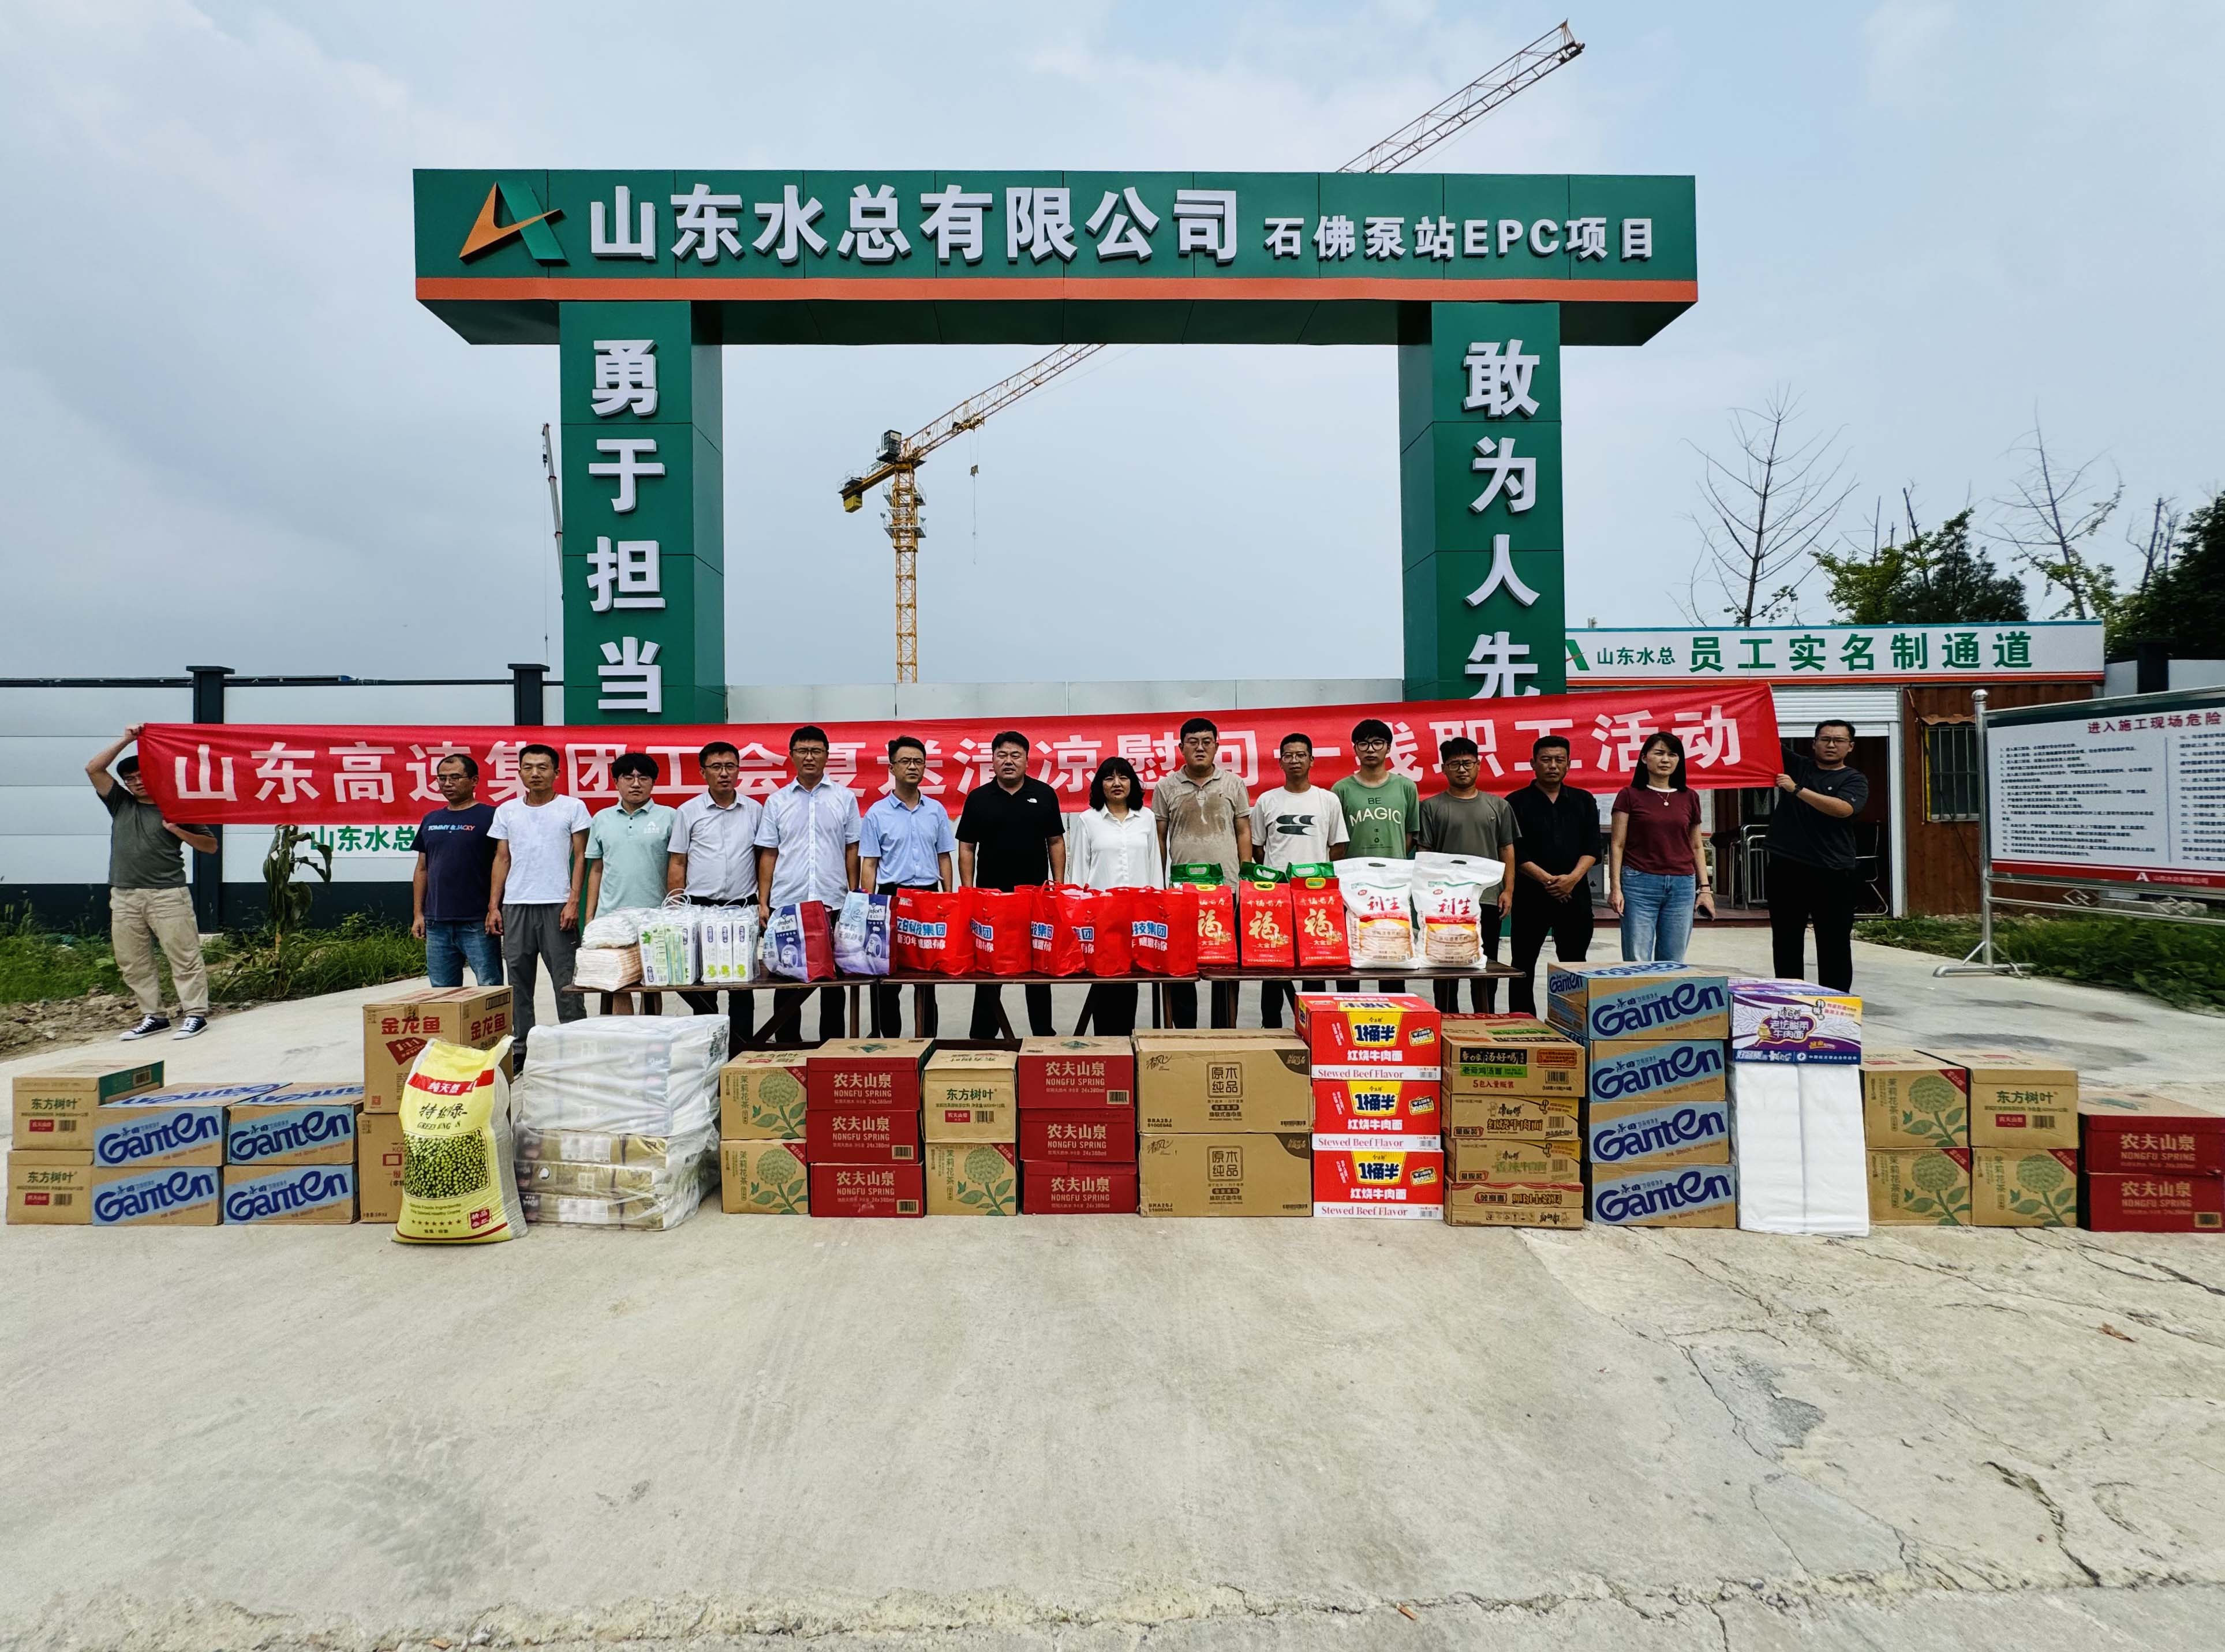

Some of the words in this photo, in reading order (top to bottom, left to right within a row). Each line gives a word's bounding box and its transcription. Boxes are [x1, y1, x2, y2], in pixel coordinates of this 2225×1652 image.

[590, 183, 1239, 264] 山东水总有限公司
[1264, 215, 1654, 262] 石佛泵站EPC项目
[586, 339, 665, 713] 勇于担当
[1463, 339, 1541, 700] 敢为人先
[1598, 647, 1676, 665] 山东水总
[1688, 630, 2033, 673] 员工实名制通道
[2088, 711, 2222, 733] 进入施工现场危险
[1349, 807, 1401, 827] MAGIC
[310, 825, 415, 852] 山东水总
[1367, 896, 1400, 912] 利生
[1438, 897, 1472, 915] 利生
[1198, 908, 1222, 938] 福
[1248, 910, 1280, 939] 福
[1304, 908, 1333, 938] 福
[381, 1016, 440, 1035] 金龙鱼
[470, 1012, 507, 1042] 金龙鱼
[1354, 1025, 1396, 1043] 1桶半
[1772, 1031, 1804, 1039] 牛肉面
[1347, 1050, 1403, 1062] 红烧牛肉面
[1045, 1061, 1105, 1076] 农夫山泉
[1211, 1067, 1238, 1080] 原木
[1318, 1069, 1349, 1078] Stewed
[1352, 1069, 1374, 1078] Beef
[1375, 1069, 1404, 1078] Flavor
[833, 1073, 892, 1088] 农夫山泉
[1046, 1078, 1075, 1086] NONGFU
[1078, 1078, 1105, 1086] SPRING
[1211, 1081, 1238, 1093] 纯品
[834, 1089, 862, 1097] NONGFU
[865, 1089, 892, 1097] SPRING
[946, 1088, 994, 1101] 东方树叶
[1996, 1091, 2054, 1104] 东方树叶
[32, 1098, 77, 1110] 东方树叶
[1354, 1094, 1396, 1111] 1桶半
[832, 1116, 890, 1132] 农夫山泉
[1047, 1123, 1107, 1140] 农夫山泉
[1347, 1119, 1403, 1130] 红烧牛肉面
[832, 1133, 861, 1141] NONGFU
[863, 1133, 890, 1141] SPRING
[1318, 1137, 1349, 1147] Stewed
[1352, 1137, 1374, 1147] Beef
[1375, 1138, 1404, 1147] Flavor
[2120, 1133, 2196, 1151] 农夫山泉
[1048, 1141, 1077, 1149] NONGFU
[1079, 1141, 1107, 1149] SPRING
[1211, 1151, 1239, 1163] 原木
[2121, 1152, 2158, 1160] NONGFU
[2161, 1153, 2196, 1162] SPRING
[28, 1171, 74, 1183] 东方树叶
[1212, 1164, 1239, 1177] 纯品
[1358, 1162, 1400, 1180] 1桶半
[836, 1171, 895, 1186] 农夫山泉
[1051, 1177, 1110, 1193] 农夫山泉
[837, 1188, 866, 1196] NONGFU
[868, 1188, 895, 1196] SPRING
[1350, 1188, 1407, 1200] 红烧牛肉面
[2121, 1181, 2192, 1197] 农夫山泉
[1051, 1193, 1080, 1201] NONGFU
[1083, 1193, 1110, 1201] SPRING
[2122, 1199, 2157, 1208] NONGFU
[2160, 1199, 2192, 1208] SPRING
[1321, 1205, 1353, 1215] Stewed
[1356, 1206, 1377, 1216] Beef
[1379, 1206, 1408, 1217] Flavor
